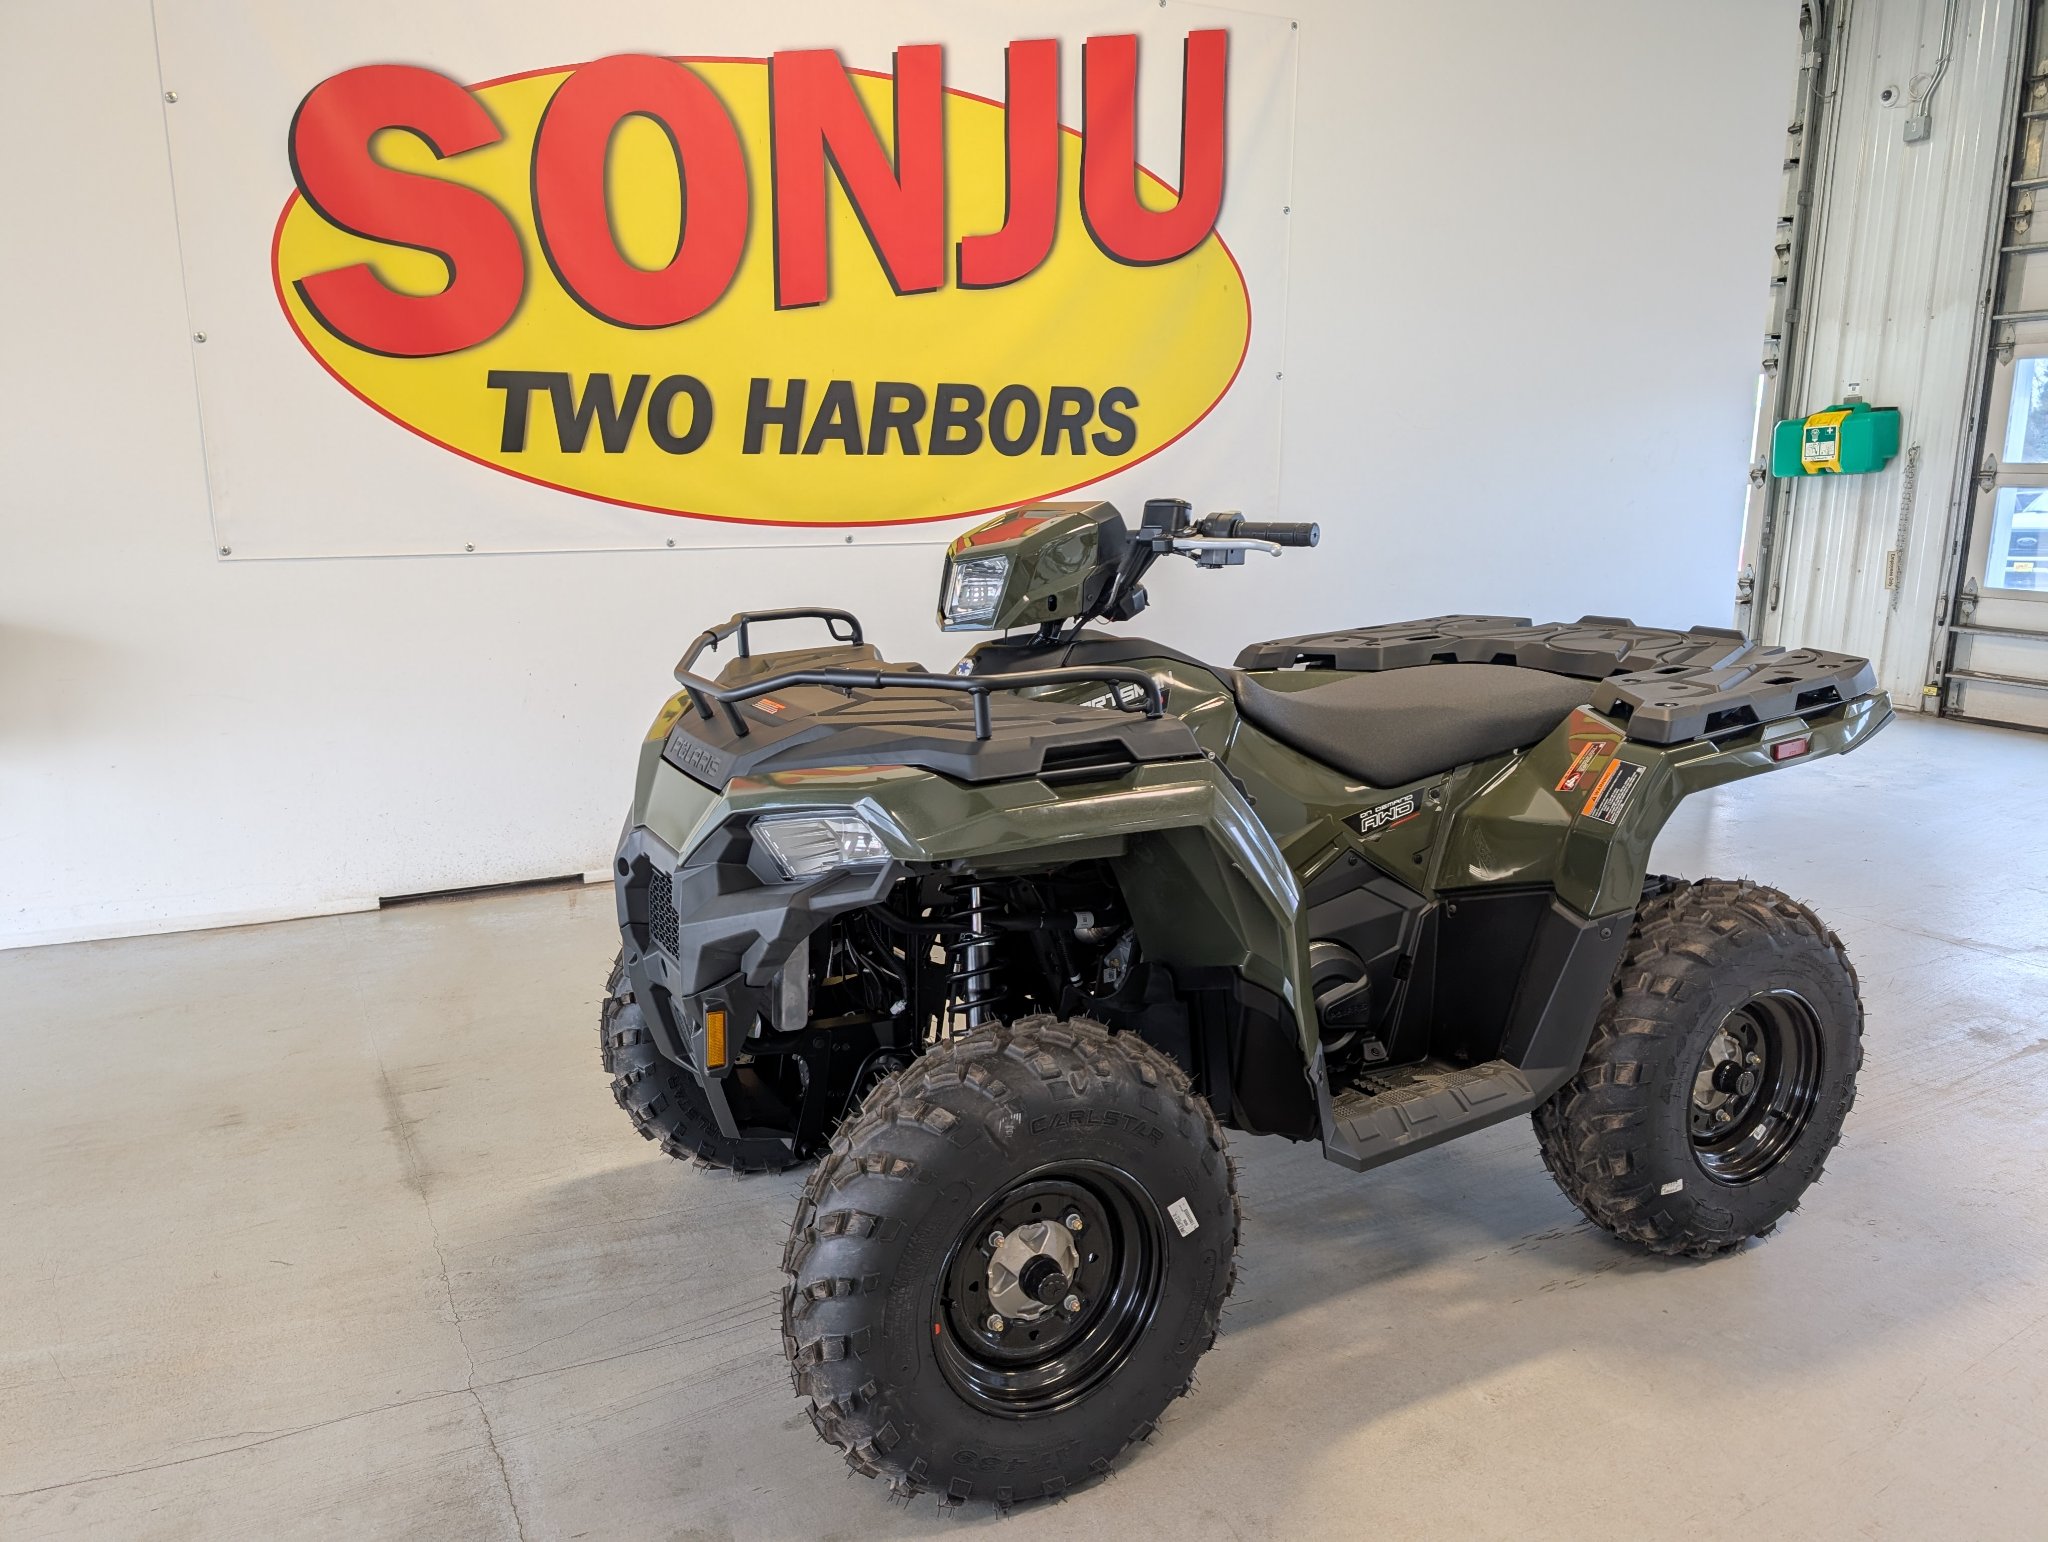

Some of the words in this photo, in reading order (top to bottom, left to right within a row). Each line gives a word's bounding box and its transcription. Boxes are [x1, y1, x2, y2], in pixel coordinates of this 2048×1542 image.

[289, 28, 1228, 358] SONJU
[487, 371, 713, 454] TWO
[742, 377, 1139, 455] HARBORS
[670, 736, 721, 777] POLARIS
[1594, 772, 1611, 796] WARNING
[1360, 810, 1373, 819] ON
[1375, 794, 1413, 812] DEMAND
[1361, 800, 1414, 832] AWD
[1030, 1108, 1165, 1148] CARLSTAR
